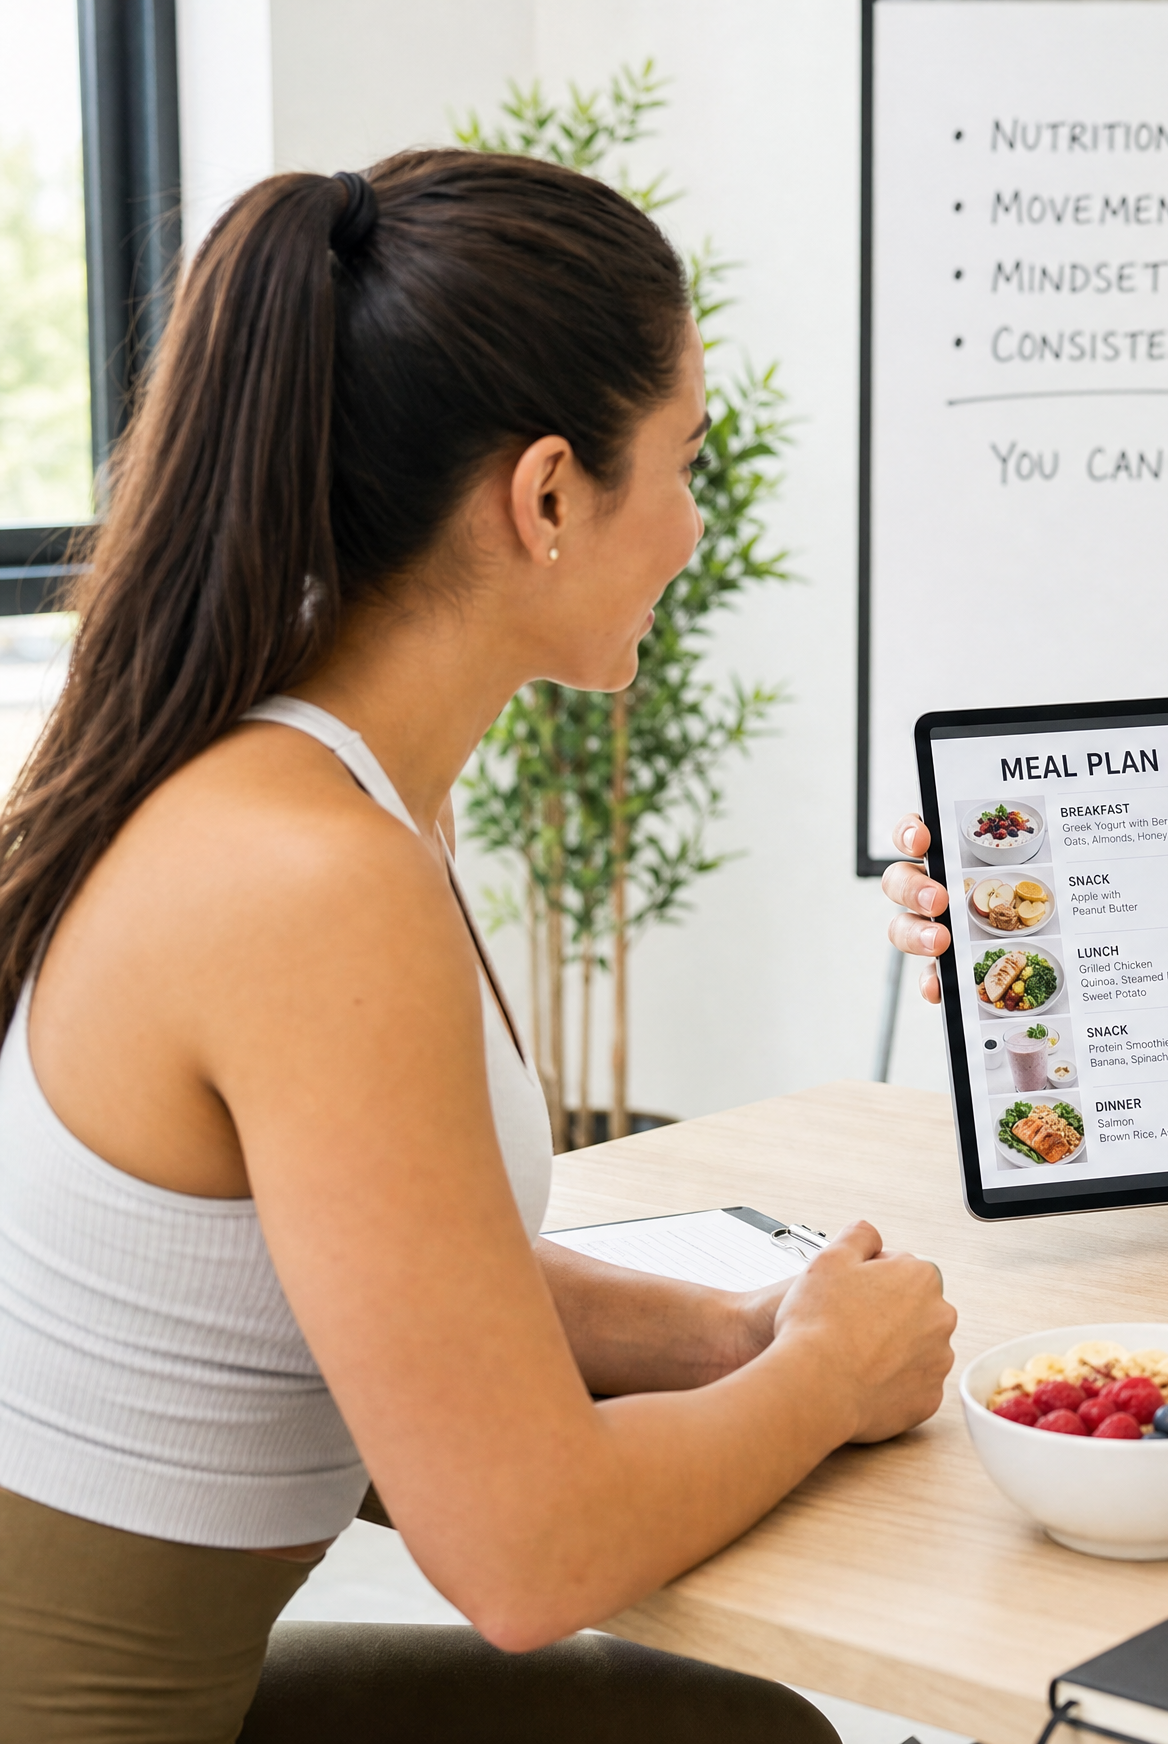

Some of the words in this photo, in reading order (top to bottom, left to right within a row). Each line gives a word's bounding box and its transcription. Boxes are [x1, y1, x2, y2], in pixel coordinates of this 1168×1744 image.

[990, 442, 1059, 485] YOU
[1086, 446, 1164, 481] CAN
[1001, 755, 1077, 781] MEAL
[1087, 749, 1159, 776] PLAN
[1060, 804, 1129, 817] BREAKFAST
[1063, 823, 1092, 832] Greek
[1095, 821, 1126, 831] Yogurt
[1129, 819, 1148, 827] with
[1092, 834, 1135, 844] Almonds,
[1138, 832, 1167, 841] Honey
[1069, 874, 1110, 886] SNACK
[1071, 892, 1098, 904] Apple
[1101, 890, 1121, 899] with
[1073, 906, 1106, 915] Peanut
[1109, 904, 1138, 913] Butter
[1077, 945, 1119, 958] LUNCH
[1079, 963, 1110, 973] Grilled
[1114, 961, 1152, 971] Chicken
[1121, 972, 1163, 984] Steamed
[1083, 991, 1112, 1001] Sweet
[1116, 989, 1146, 998] Potato
[1087, 1025, 1128, 1038] SNACK
[1089, 1042, 1122, 1053] Protein
[1090, 1057, 1128, 1067] Banana,
[1096, 1098, 1141, 1112] DINNER
[1098, 1118, 1134, 1128] Salmon
[1100, 1133, 1130, 1143] Brown
[1133, 1130, 1157, 1139] Rice,
